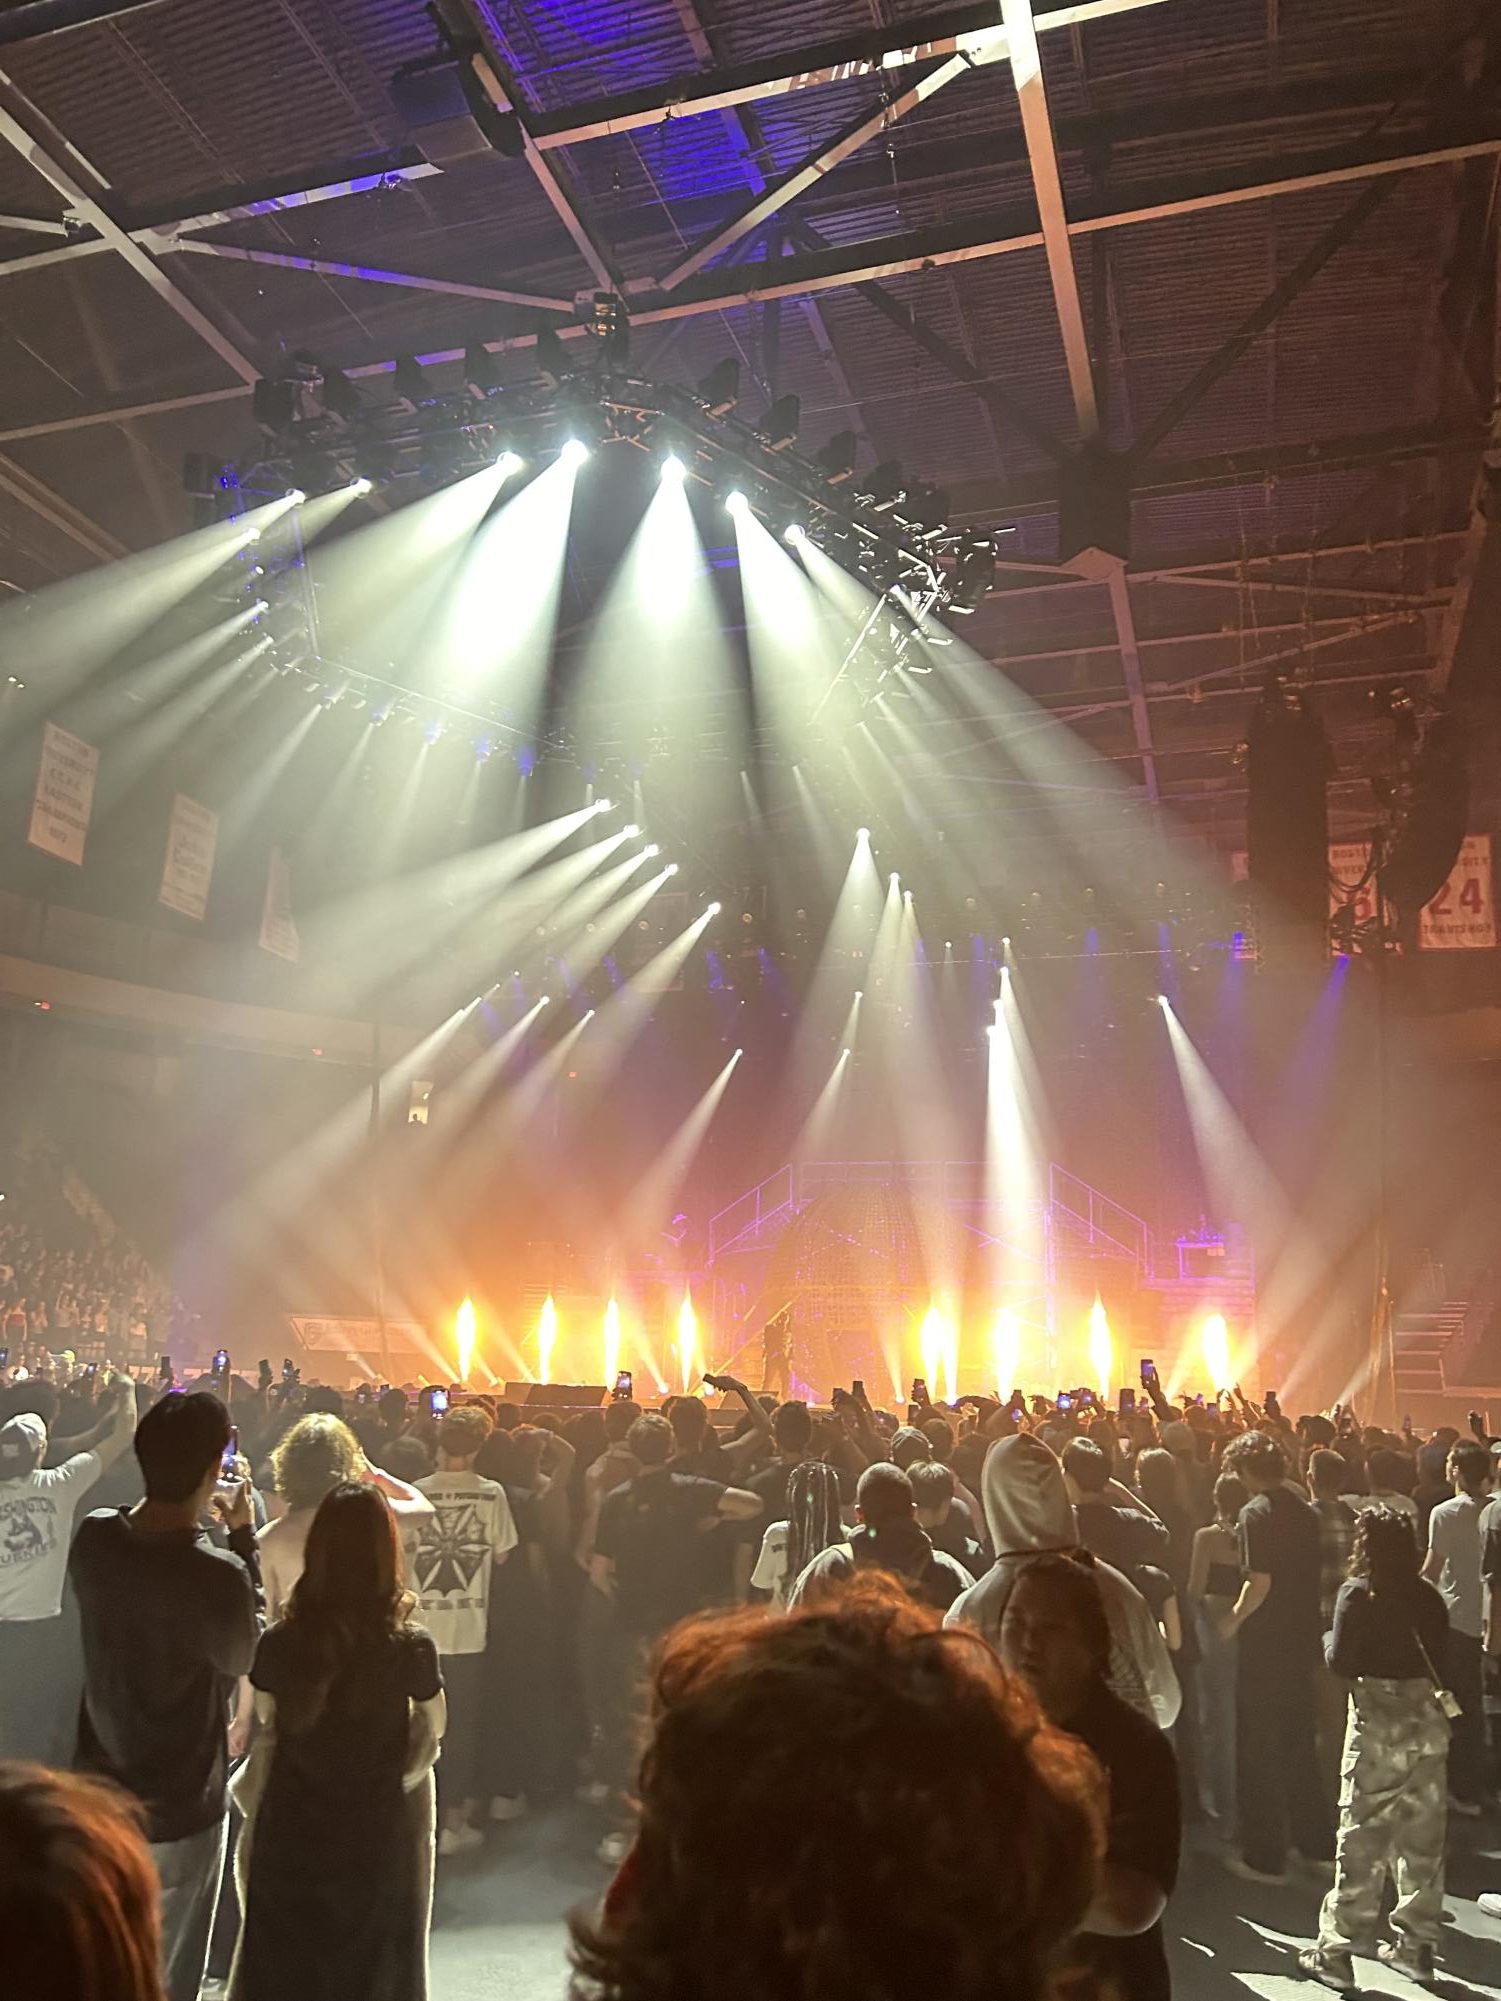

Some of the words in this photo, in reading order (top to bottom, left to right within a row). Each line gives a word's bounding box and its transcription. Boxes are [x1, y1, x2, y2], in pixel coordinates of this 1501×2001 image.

[1332, 849, 1362, 858] BOST
[1429, 878, 1484, 915] 24
[0, 1496, 57, 1521] SHINGTON
